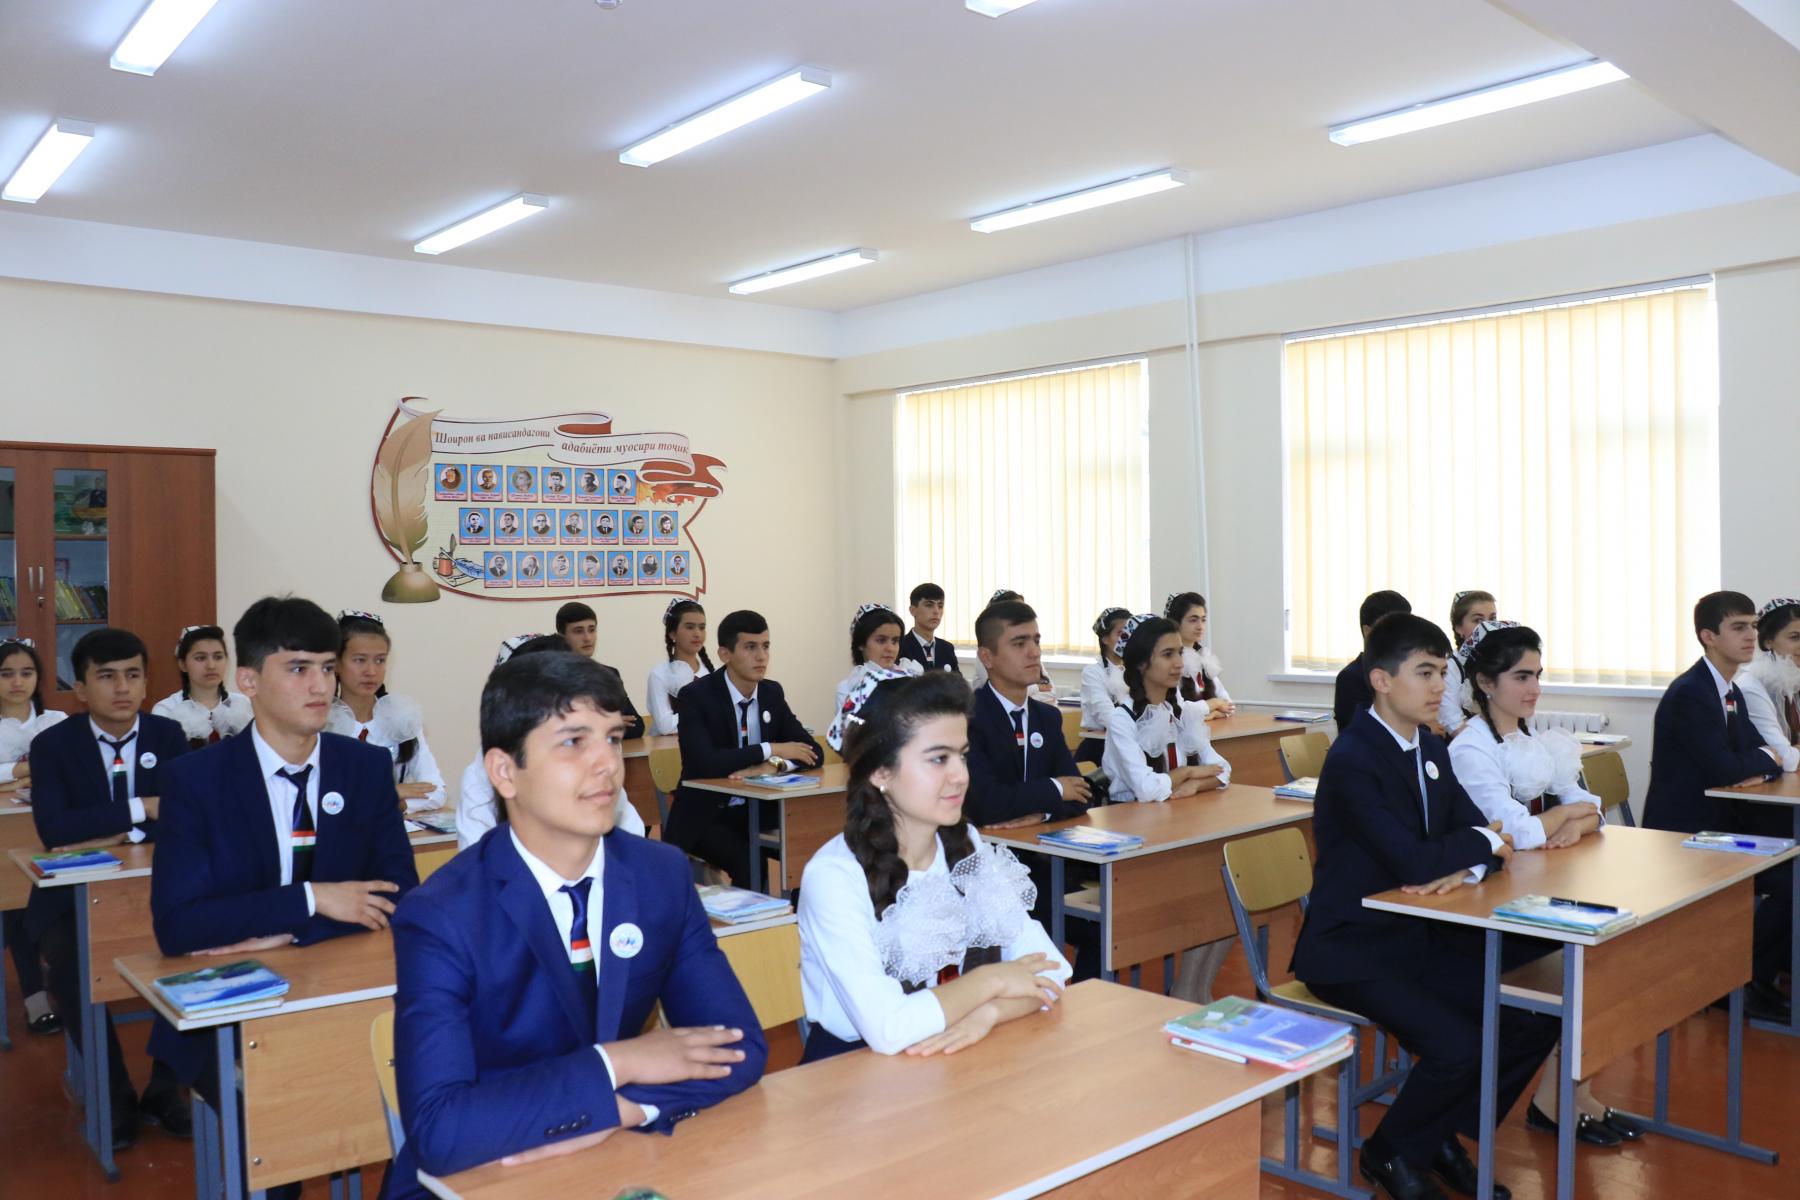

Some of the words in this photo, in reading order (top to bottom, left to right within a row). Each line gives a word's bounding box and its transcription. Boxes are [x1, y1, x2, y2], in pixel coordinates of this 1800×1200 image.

[436, 431, 474, 446] Шоирон
[475, 433, 486, 442] ва
[488, 428, 550, 441] нависандагони
[561, 442, 612, 454] адабиёти
[614, 442, 655, 456] муосири
